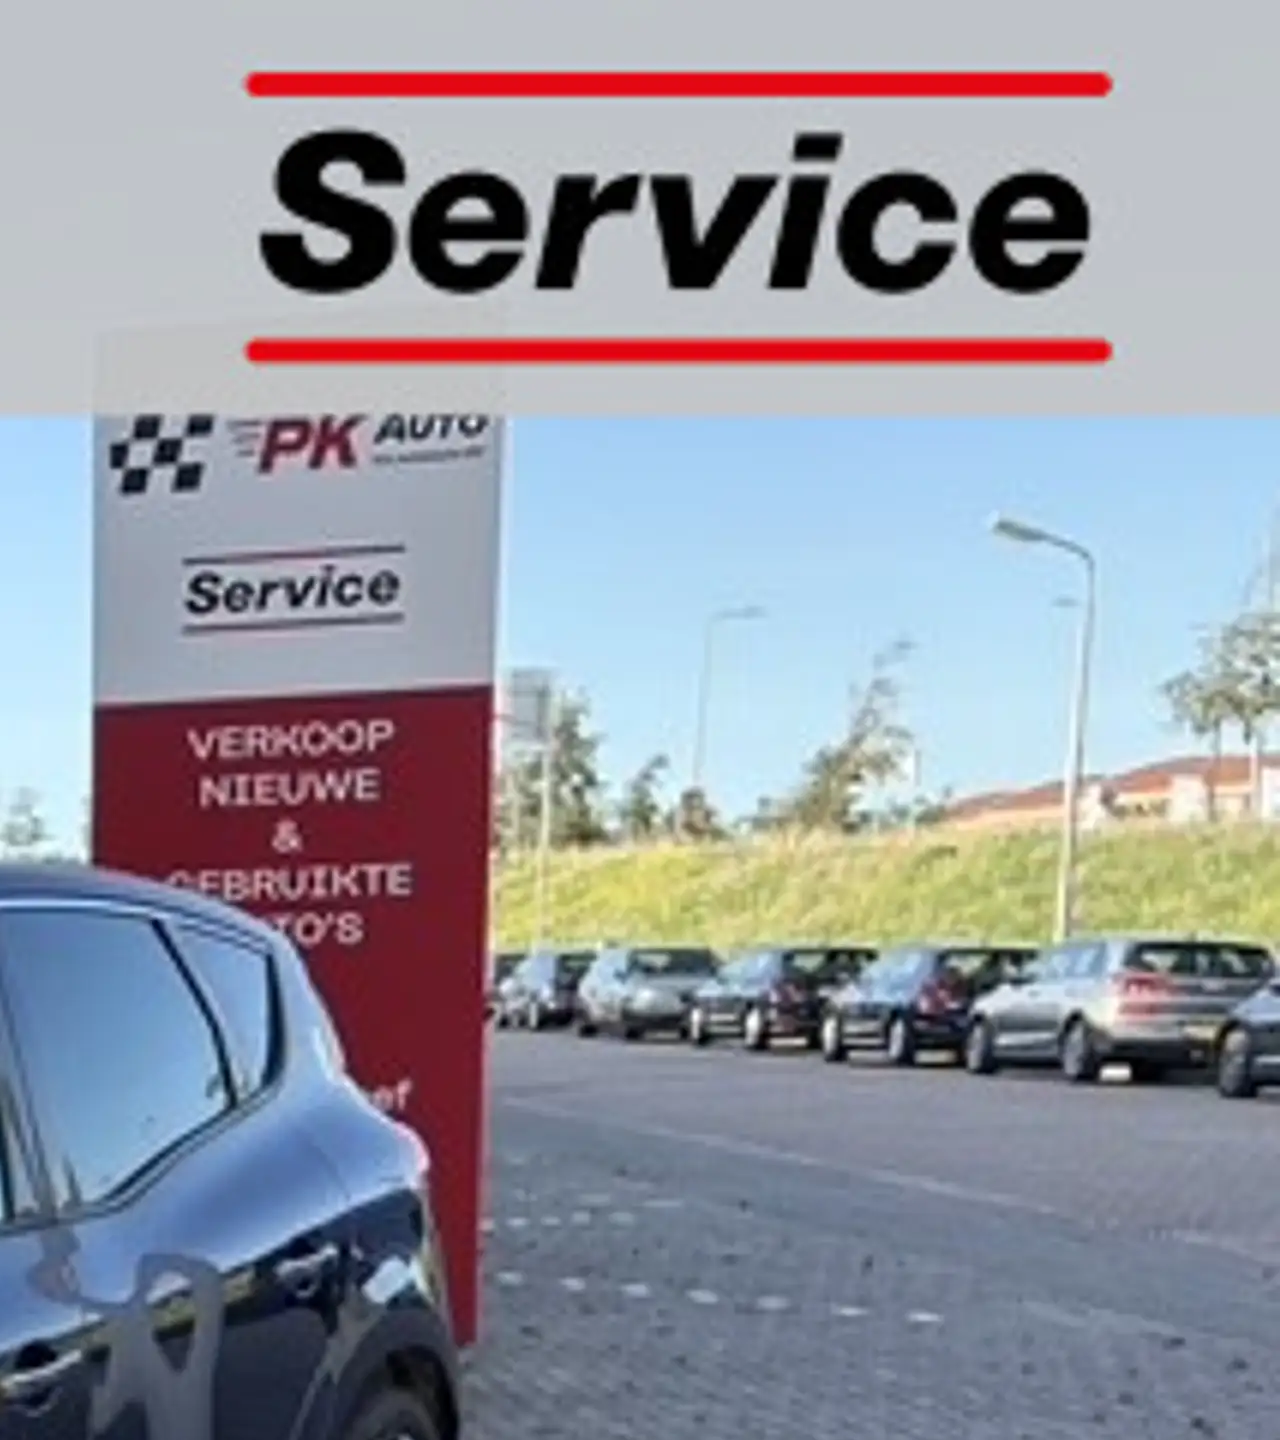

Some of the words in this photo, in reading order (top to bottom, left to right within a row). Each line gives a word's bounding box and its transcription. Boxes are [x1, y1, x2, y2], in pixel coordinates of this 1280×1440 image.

[258, 413, 366, 473] PK
[374, 413, 490, 444] AUTO
[185, 565, 401, 615] Service
[187, 718, 394, 760] VERKOOP
[199, 767, 381, 808] NIEUWE
[271, 820, 304, 854] &
